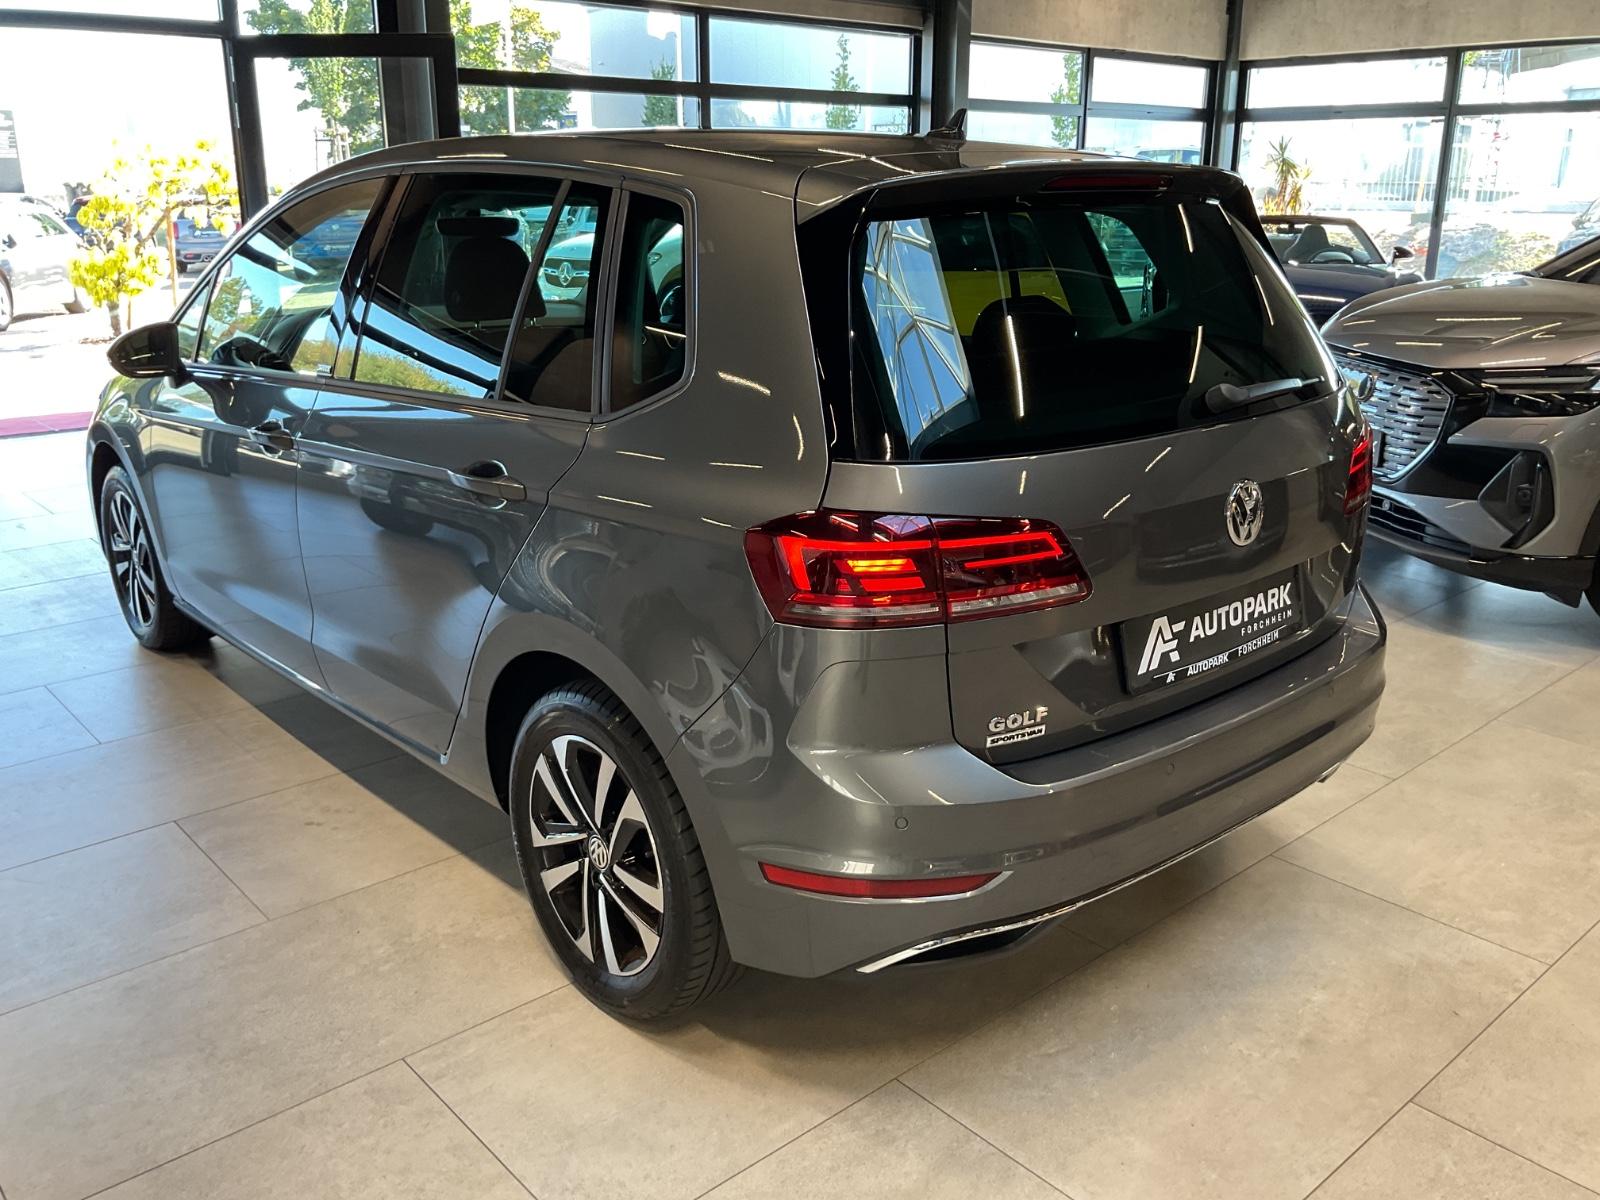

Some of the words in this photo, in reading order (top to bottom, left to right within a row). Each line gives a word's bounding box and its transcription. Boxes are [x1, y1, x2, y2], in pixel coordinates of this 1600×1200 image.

[1189, 582, 1292, 643] AUTOPARK
[1241, 608, 1292, 637] FORCHHEIM
[1187, 652, 1230, 677] AUTOPARK
[1238, 630, 1280, 657] FORCHHEIM
[988, 706, 1049, 732] GOLF
[989, 727, 1043, 745] SPORTSVAN
